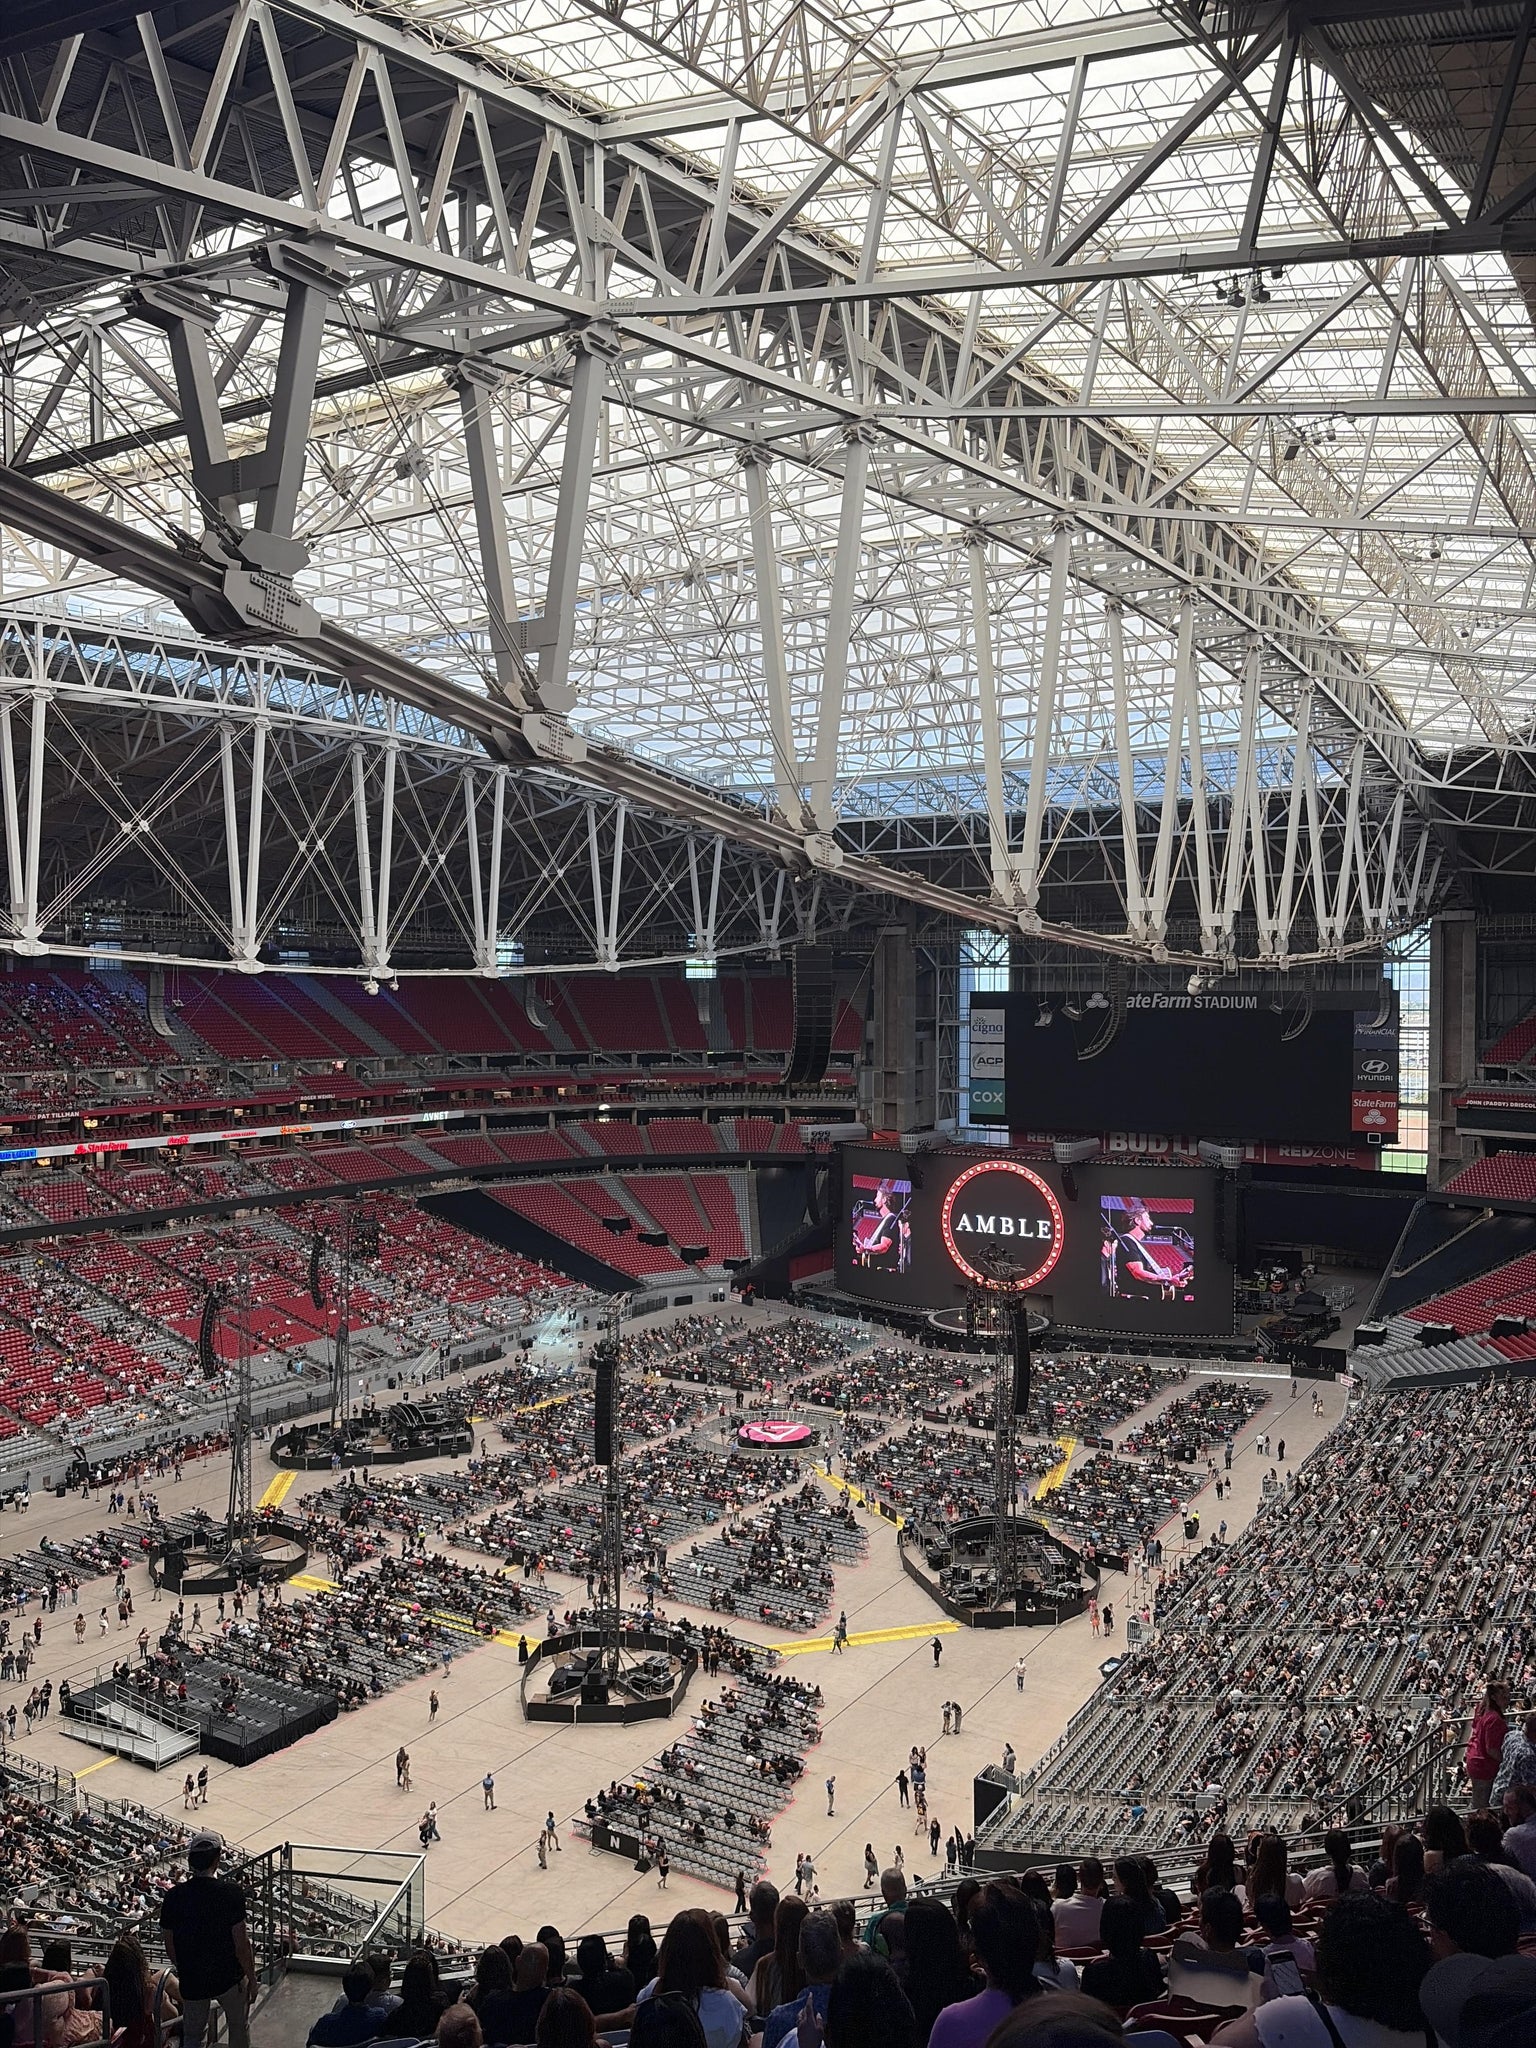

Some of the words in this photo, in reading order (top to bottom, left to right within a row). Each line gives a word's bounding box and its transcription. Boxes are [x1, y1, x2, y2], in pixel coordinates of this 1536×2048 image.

[1126, 993, 1192, 1009] ateFarm
[1194, 996, 1257, 1009] STADIUM
[972, 1022, 1004, 1035] cigna
[977, 1056, 1004, 1065] ACP
[1357, 1074, 1394, 1082] HYUNDAI
[972, 1091, 1003, 1103] COX
[1353, 1098, 1397, 1108] StateFarm
[51, 1111, 80, 1119] TILLMAN
[1110, 1131, 1168, 1153] BUD
[1279, 1145, 1356, 1160] REDZONE
[955, 1213, 1052, 1240] AMBLE
[610, 1834, 620, 1849] N
